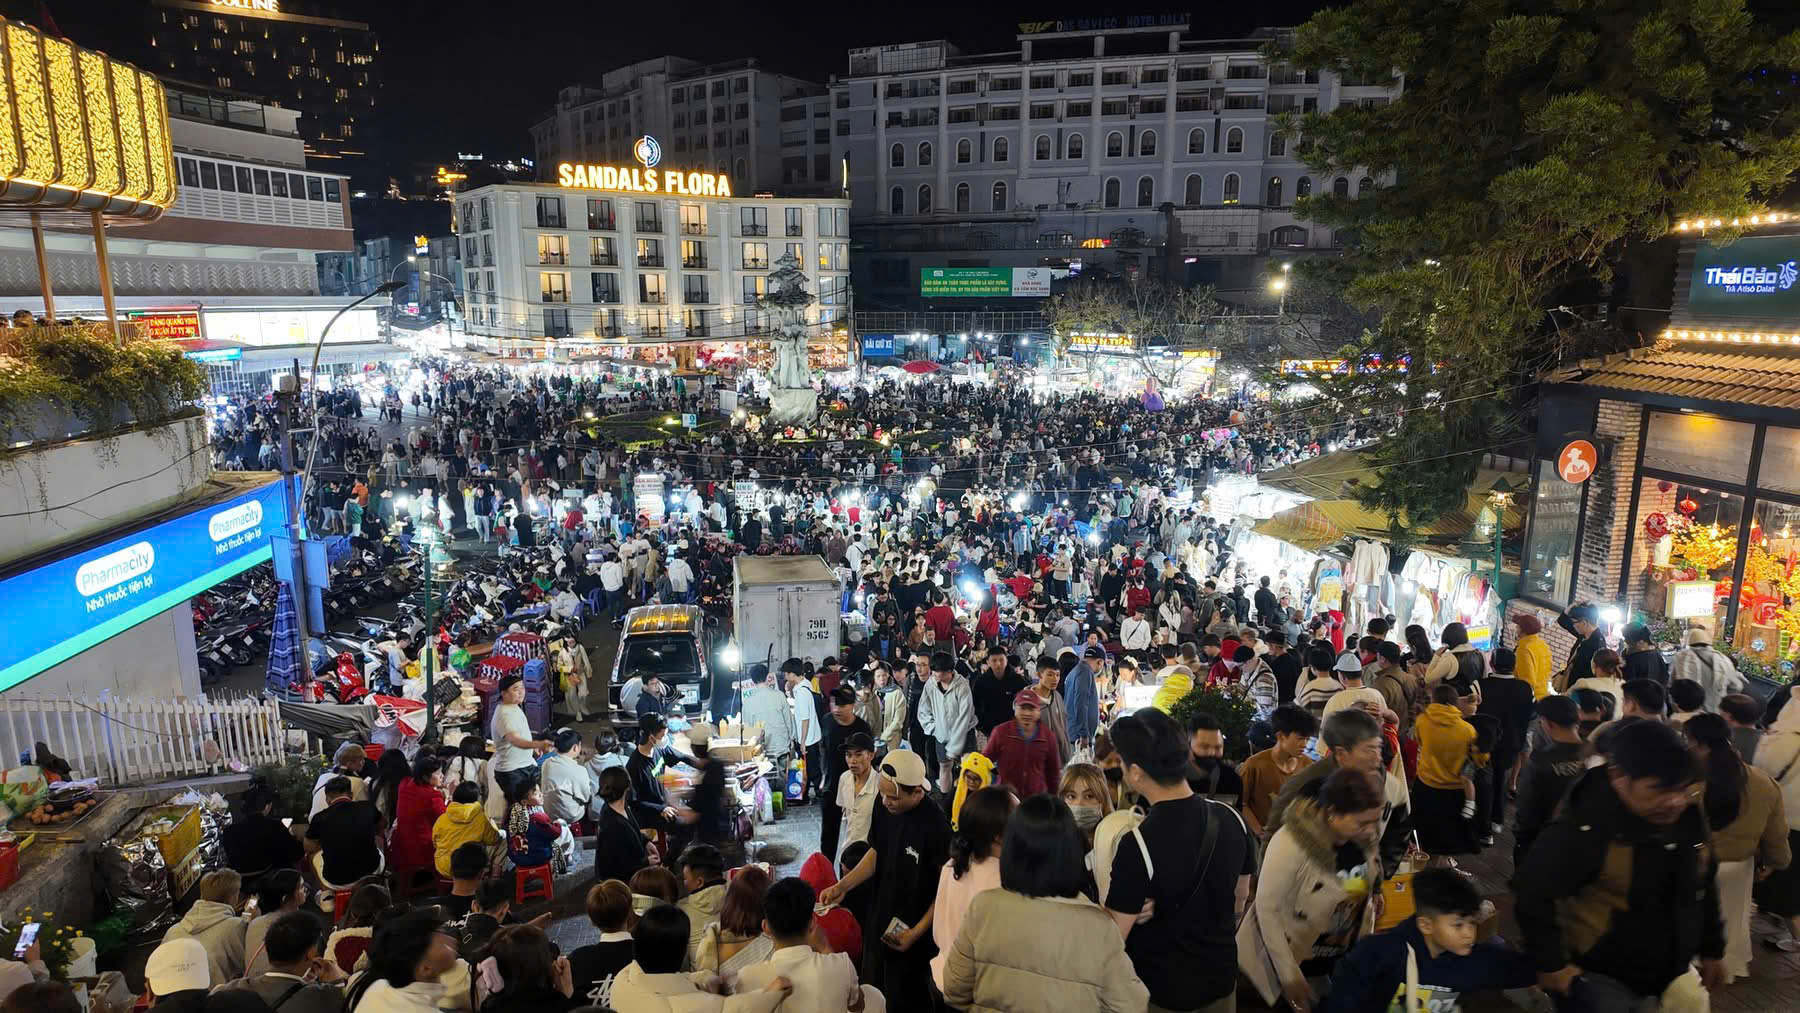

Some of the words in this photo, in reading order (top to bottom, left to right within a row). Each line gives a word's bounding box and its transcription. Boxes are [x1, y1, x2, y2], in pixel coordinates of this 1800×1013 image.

[558, 163, 658, 192] SANDALS
[665, 170, 731, 197] FLORA
[1705, 267, 1742, 285] Thái
[1742, 267, 1778, 284] Bảo
[213, 504, 259, 537] Pharmacity
[215, 541, 229, 556] Nhà
[81, 549, 149, 591] Pharmacity
[85, 595, 105, 614] Nhà
[104, 583, 128, 605] thuốc
[128, 579, 144, 594] tiện
[143, 573, 154, 589] lợi
[806, 630, 829, 640] 9562
